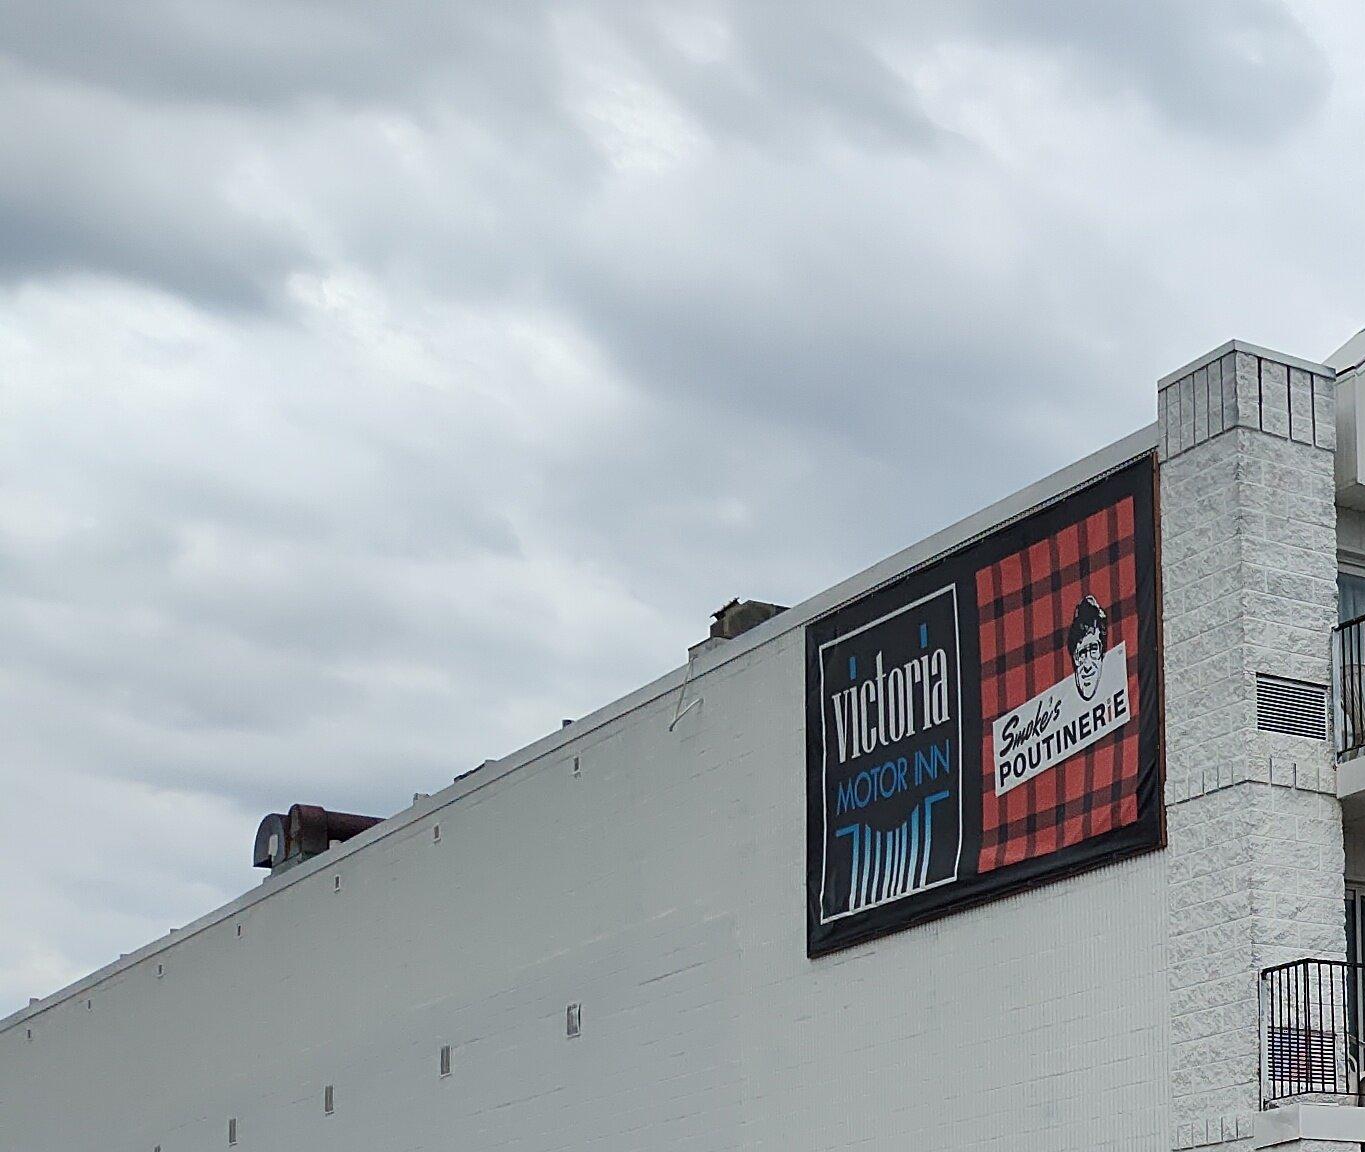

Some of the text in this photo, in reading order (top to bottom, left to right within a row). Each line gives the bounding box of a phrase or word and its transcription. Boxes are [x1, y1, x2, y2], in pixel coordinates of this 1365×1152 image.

[831, 624, 951, 764] victoria
[1000, 697, 1063, 758] Smoke's
[838, 741, 951, 815] MOTOR INN
